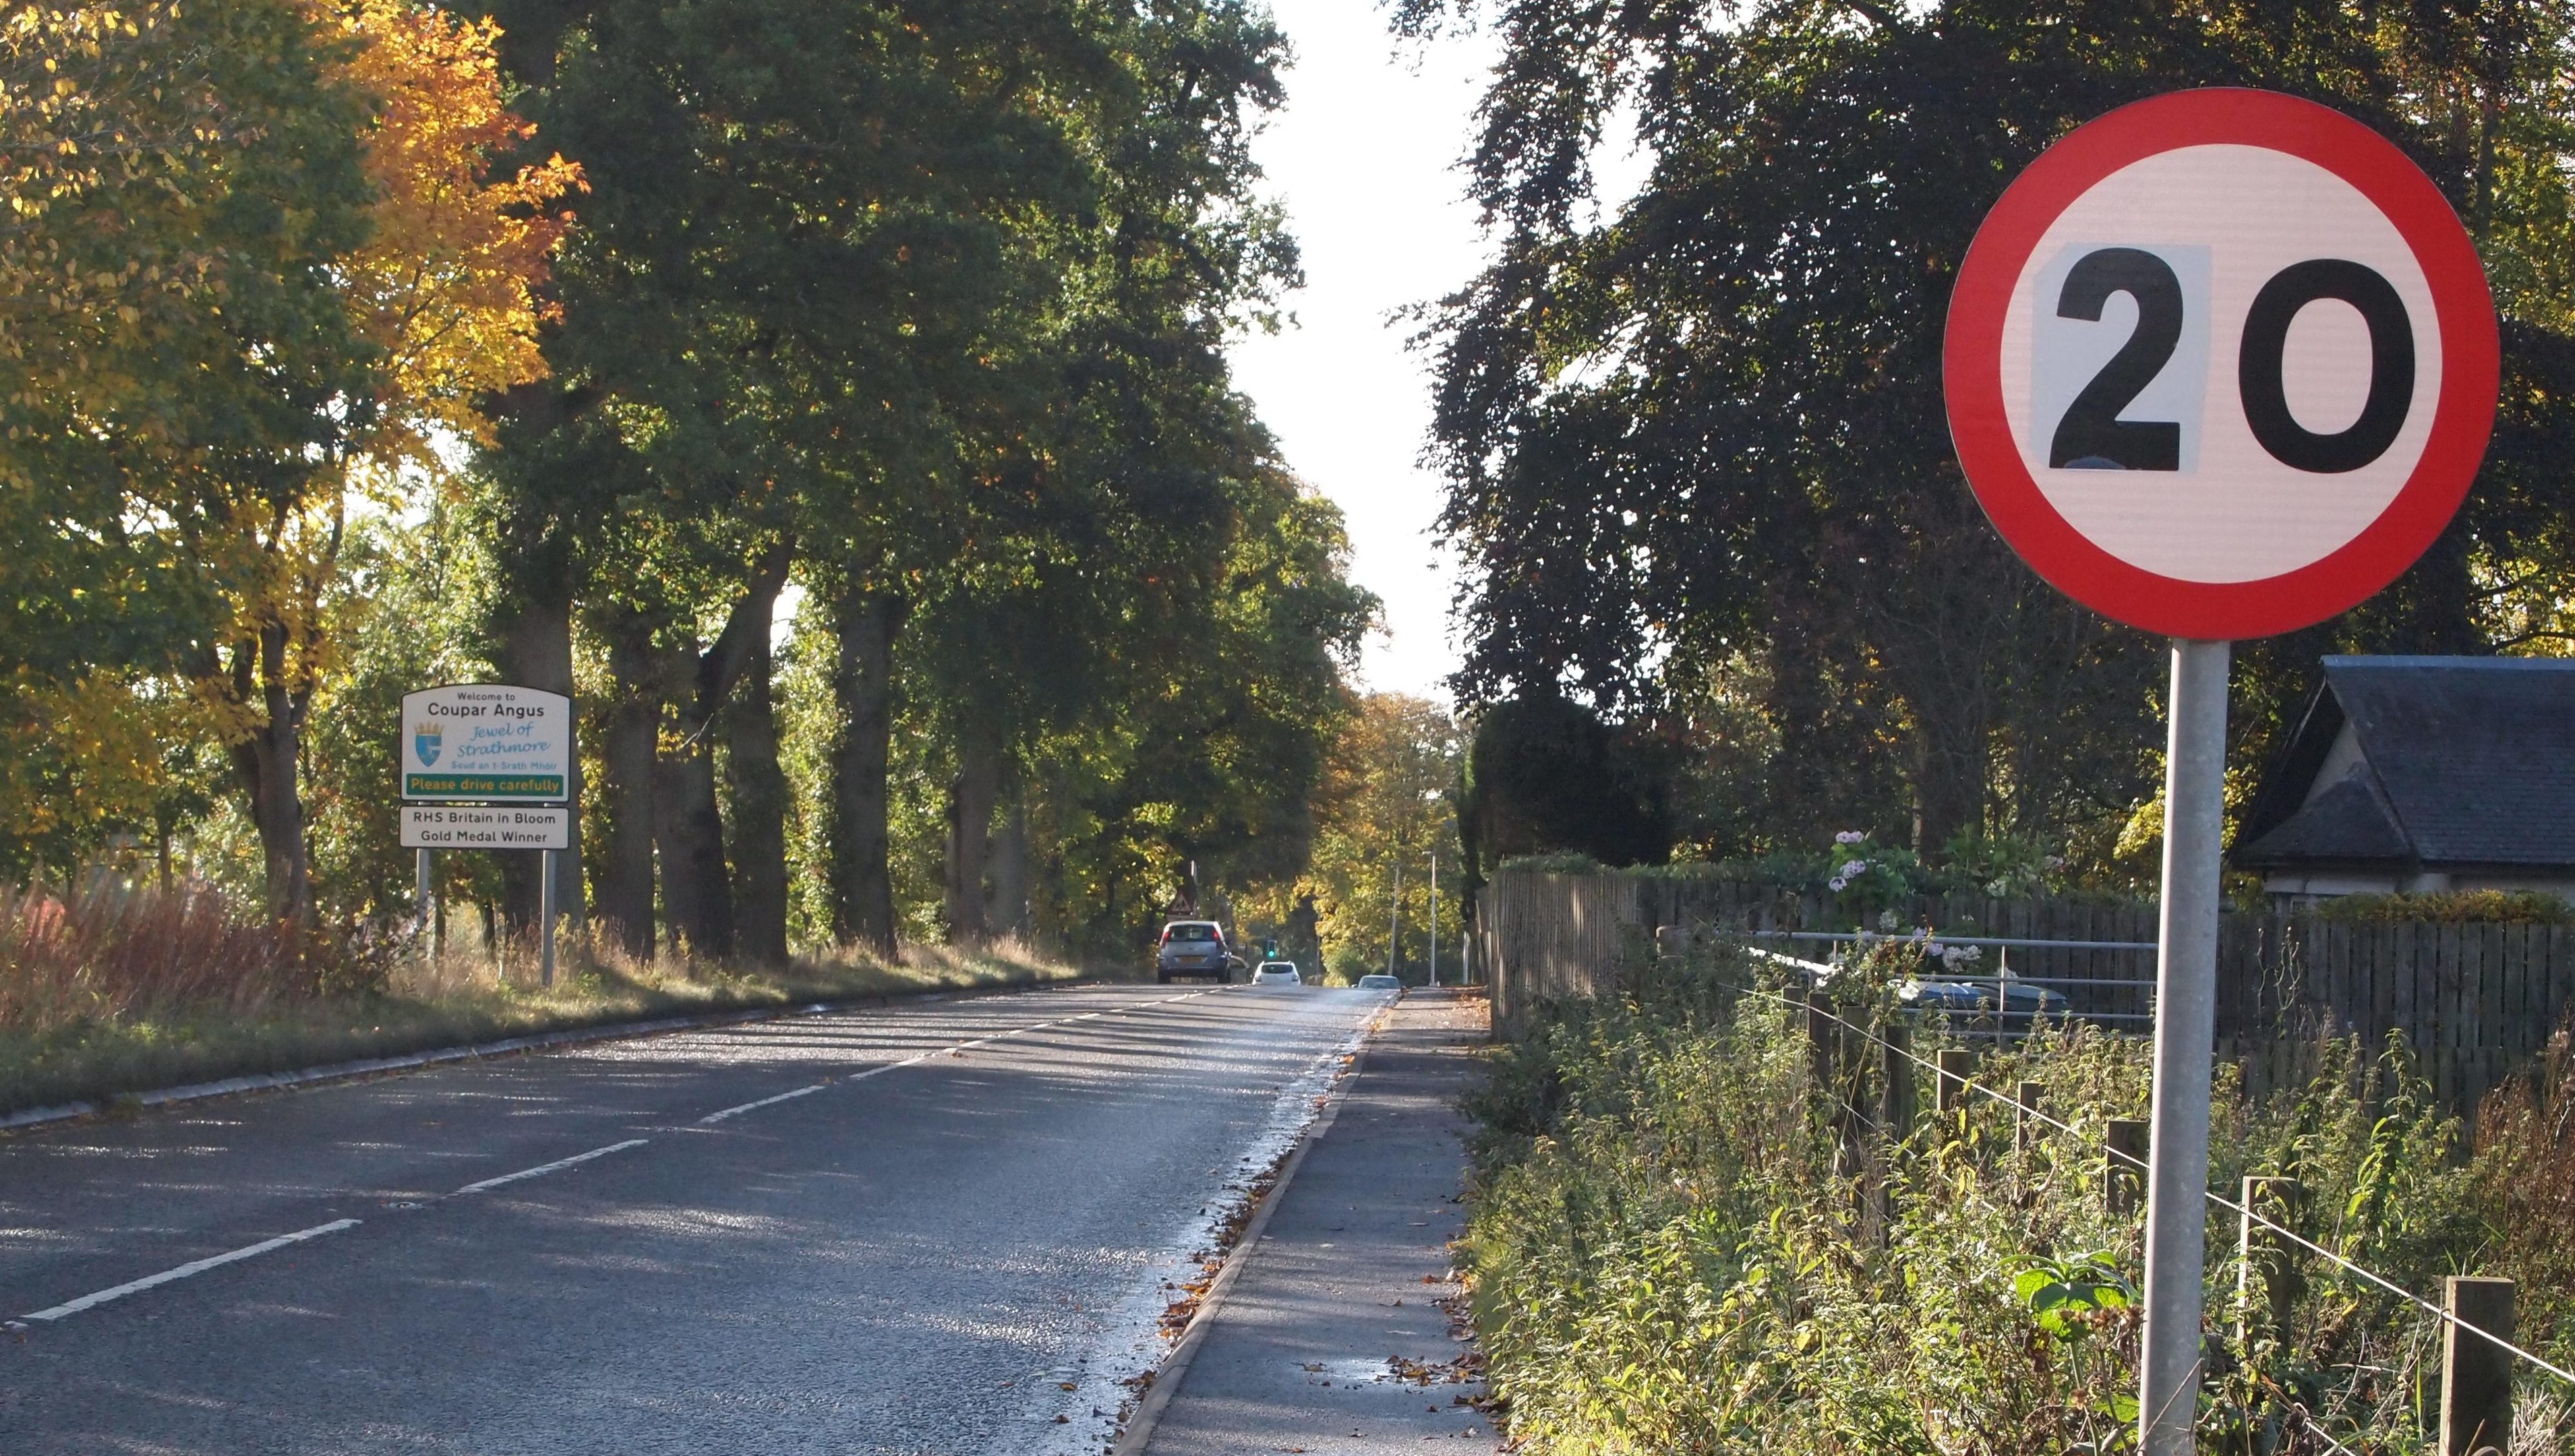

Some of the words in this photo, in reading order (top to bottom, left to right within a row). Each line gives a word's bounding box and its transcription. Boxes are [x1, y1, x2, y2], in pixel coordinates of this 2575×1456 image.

[2049, 247, 2416, 474] 20
[458, 692, 502, 700] Welcome
[428, 702, 487, 717] Coupar
[494, 704, 544, 719] Angus
[470, 723, 512, 741] Jewel
[517, 722, 533, 737] of
[457, 741, 551, 757] Strathmore
[411, 779, 455, 790] Please
[461, 779, 494, 790] drive
[500, 780, 559, 792] carefully
[414, 813, 442, 822] RHS
[450, 813, 492, 822] Britain
[498, 814, 508, 823] in
[515, 814, 555, 824] Bloom
[421, 831, 450, 841] Gold
[457, 832, 496, 841] Medal
[502, 832, 547, 842] Winner
